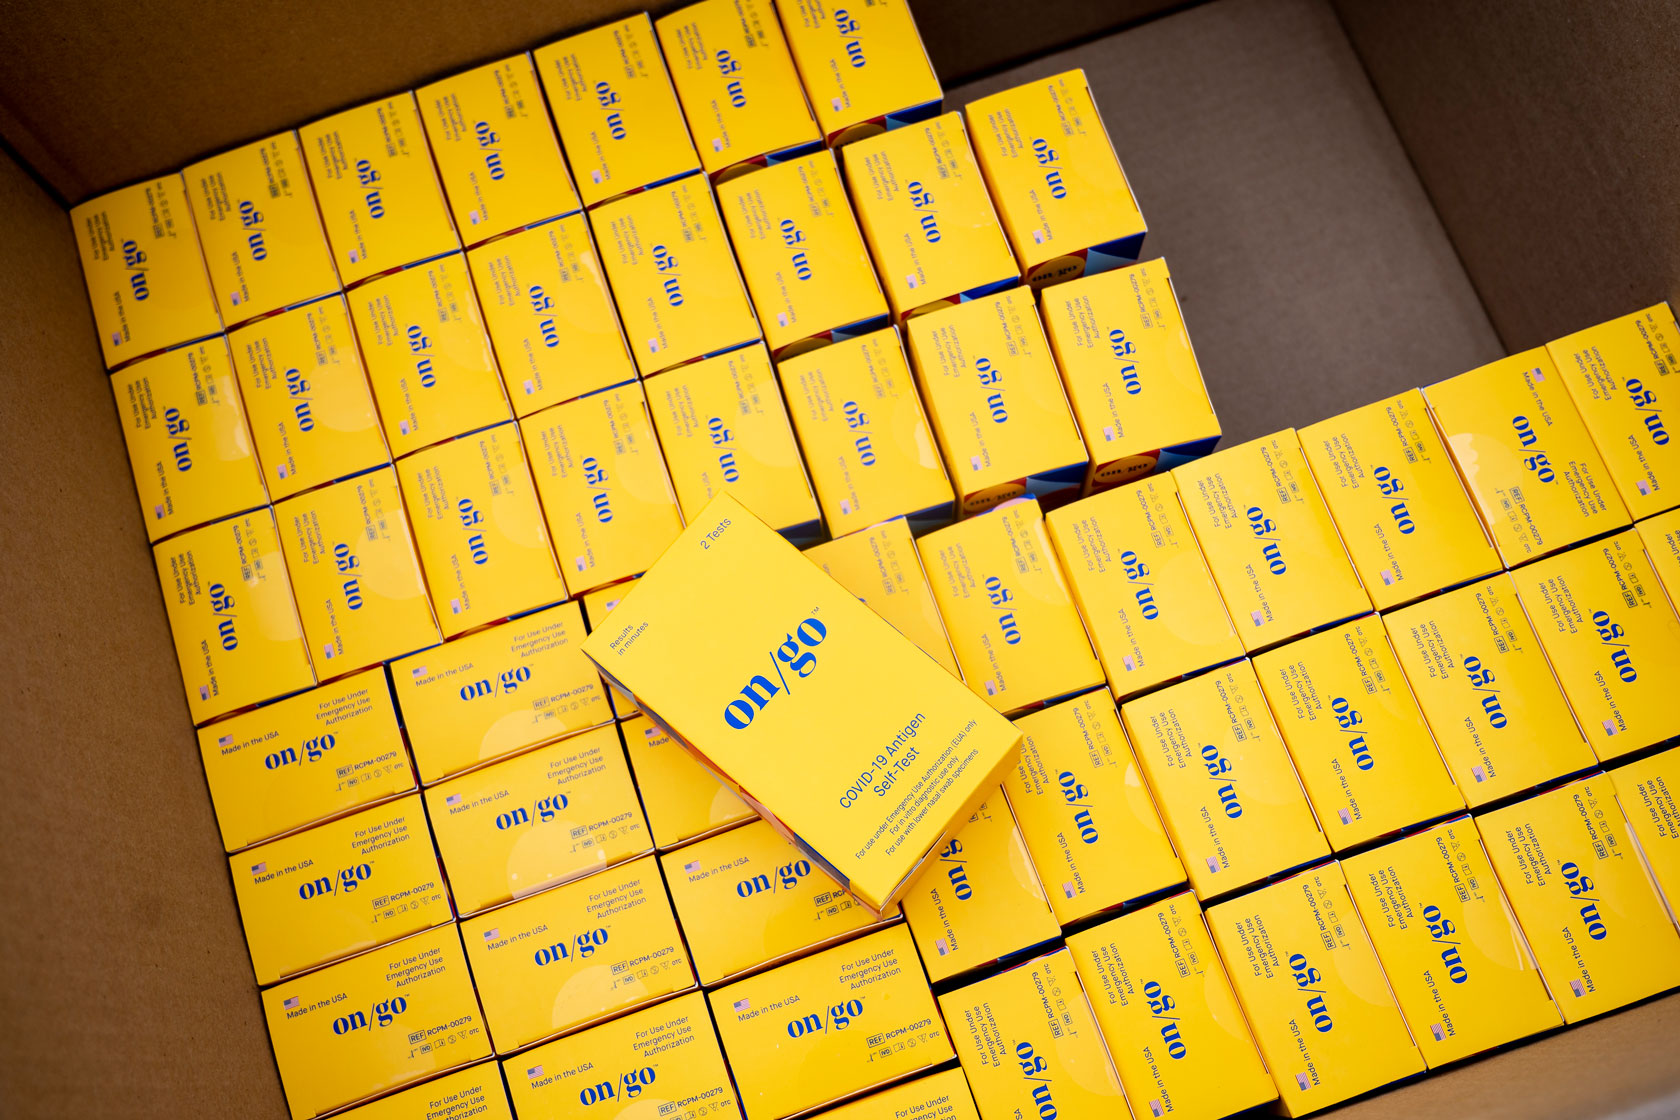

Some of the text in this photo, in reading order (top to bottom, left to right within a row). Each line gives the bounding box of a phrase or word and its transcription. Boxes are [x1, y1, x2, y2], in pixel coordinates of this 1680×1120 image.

[1214, 472, 1238, 519] Authorization
[1260, 446, 1289, 503] REF RCPM-00279
[1197, 479, 1222, 528] For Use Under
[1205, 476, 1233, 529] Emergency Use
[700, 518, 732, 550] 2 Tests
[1245, 563, 1275, 623] Made in the USA
[609, 624, 634, 650] Results
[616, 622, 649, 656] in minutes
[1428, 620, 1455, 669] Authorization
[1475, 593, 1507, 653] REF RCPM-00279
[1410, 627, 1438, 678] For Use Under
[1419, 623, 1450, 680] Emergency Use
[839, 712, 926, 809] COVID-19 Antigen
[873, 746, 920, 797] Self-Test
[1464, 716, 1497, 779] Made in the USA
[855, 719, 978, 860] For use under Emergency Use Authorization (EUA) only
[885, 748, 979, 856] For use with lower nasal swab specimens
[888, 755, 960, 836] For in vitro diagnostic use only
[1584, 786, 1593, 798] OTC
[1524, 822, 1552, 875] Authorization
[1572, 794, 1607, 859] REF RCPM-00279
[940, 839, 972, 901] on/g
[1505, 830, 1535, 885] For Use Under
[1515, 826, 1547, 887] Emergency Use
[385, 956, 444, 982] Emergency Use
[388, 947, 441, 971] For Use Under
[396, 965, 447, 988] Authorization
[839, 958, 898, 984] Emergency Use
[841, 948, 894, 973] For Use Under
[850, 967, 902, 990] Authorization
[1562, 926, 1597, 993] Made in the USA
[286, 992, 348, 1020] Made in the USA
[409, 1015, 473, 1043] REF RCPM-00279
[737, 994, 801, 1023] Made in the USA
[867, 1018, 932, 1046] REF RCPM-00279
[928, 1030, 940, 1039] OTC
